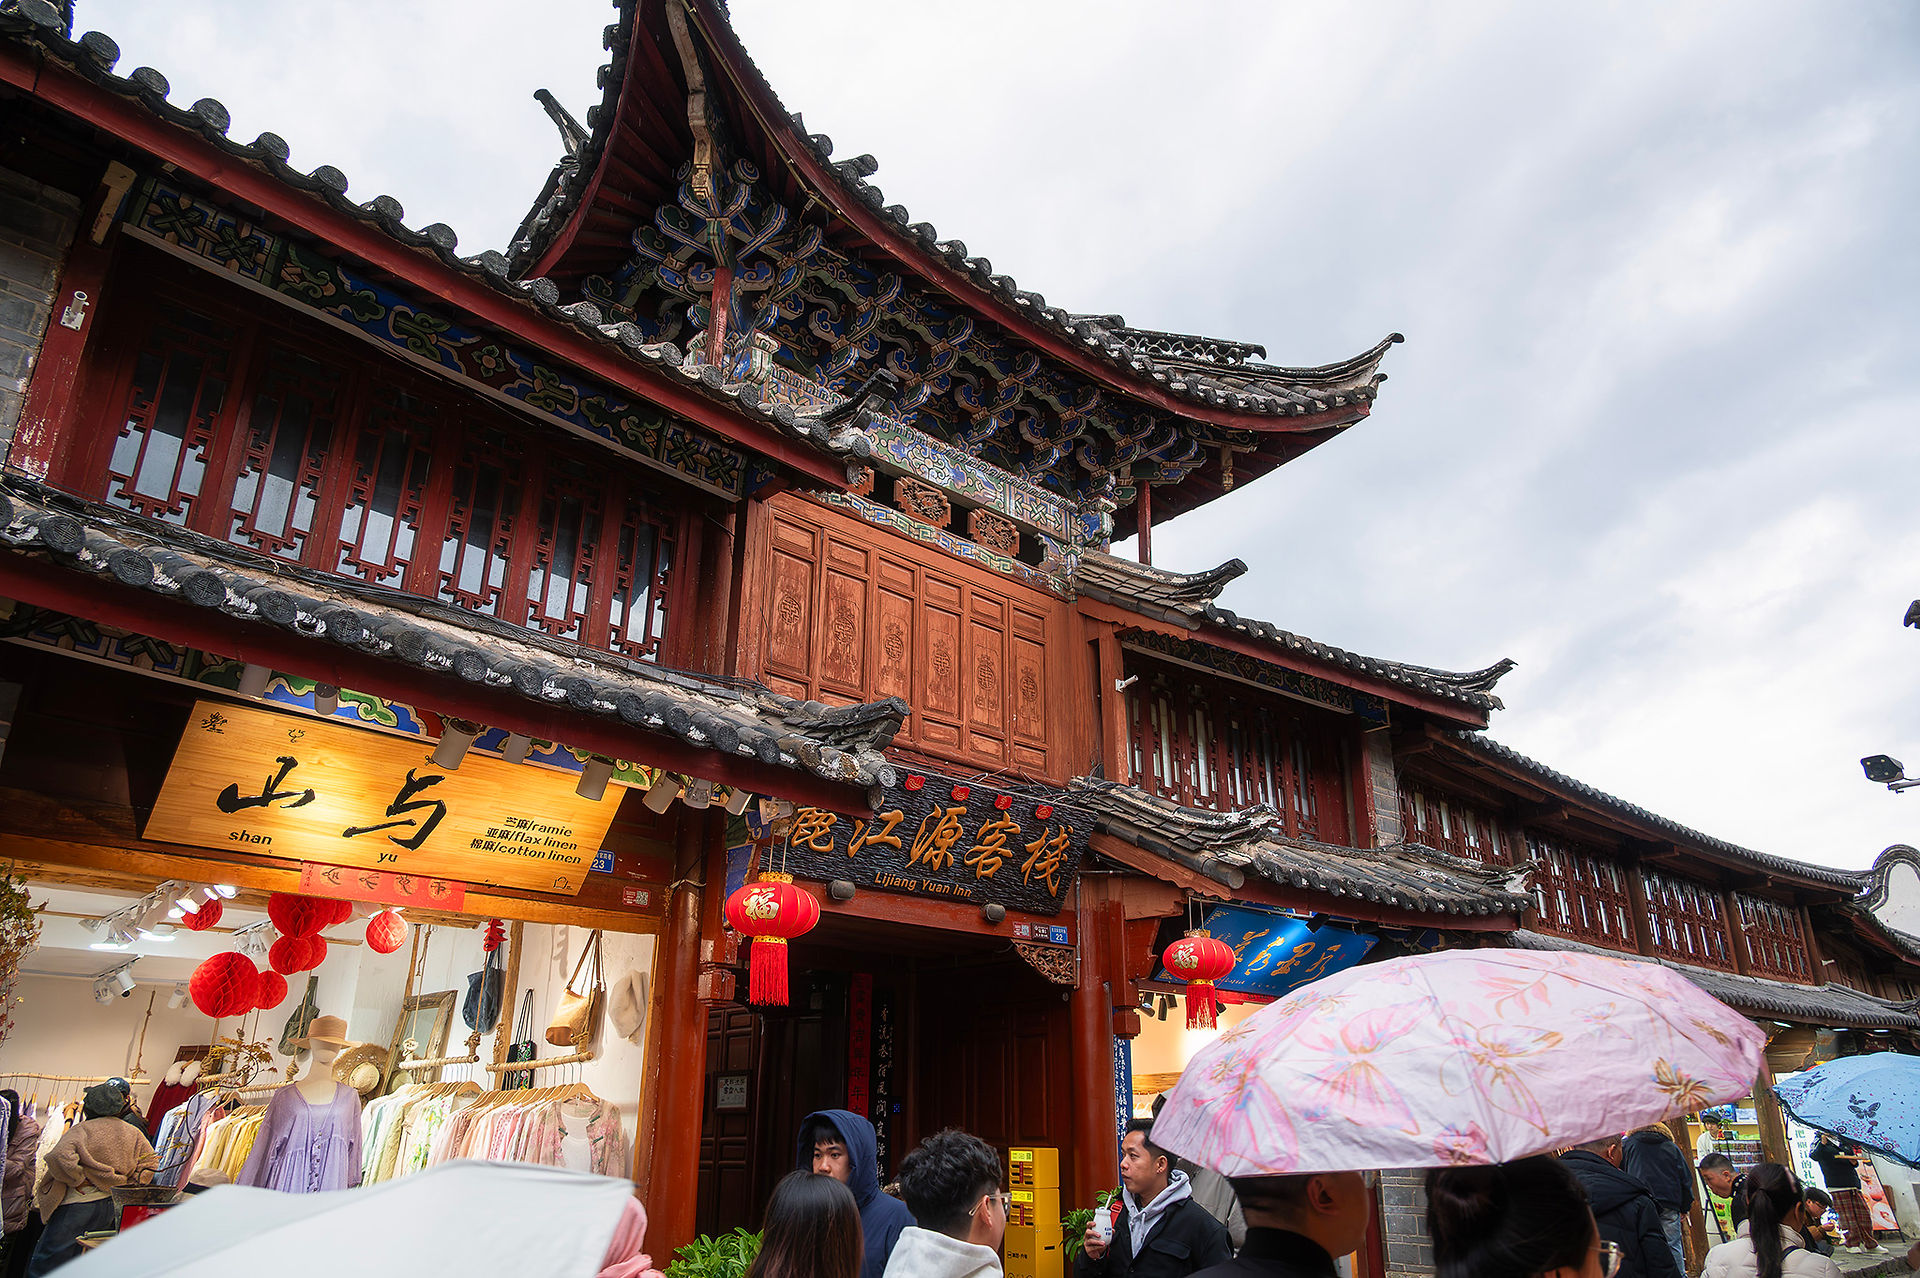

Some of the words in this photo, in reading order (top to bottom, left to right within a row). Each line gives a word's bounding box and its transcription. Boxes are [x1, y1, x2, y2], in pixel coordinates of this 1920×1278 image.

[228, 829, 273, 845] shan
[376, 852, 399, 864] yu
[470, 838, 546, 859] 棉麻/cotton
[547, 850, 582, 864] linen
[485, 827, 542, 845] 亚麻/flax
[543, 836, 578, 850] linen
[592, 858, 605, 870] 23
[874, 871, 917, 891] Lijiang
[922, 879, 950, 894] Yuan
[953, 884, 972, 897] Inn
[742, 886, 780, 921] 福
[1171, 942, 1199, 970] 福
